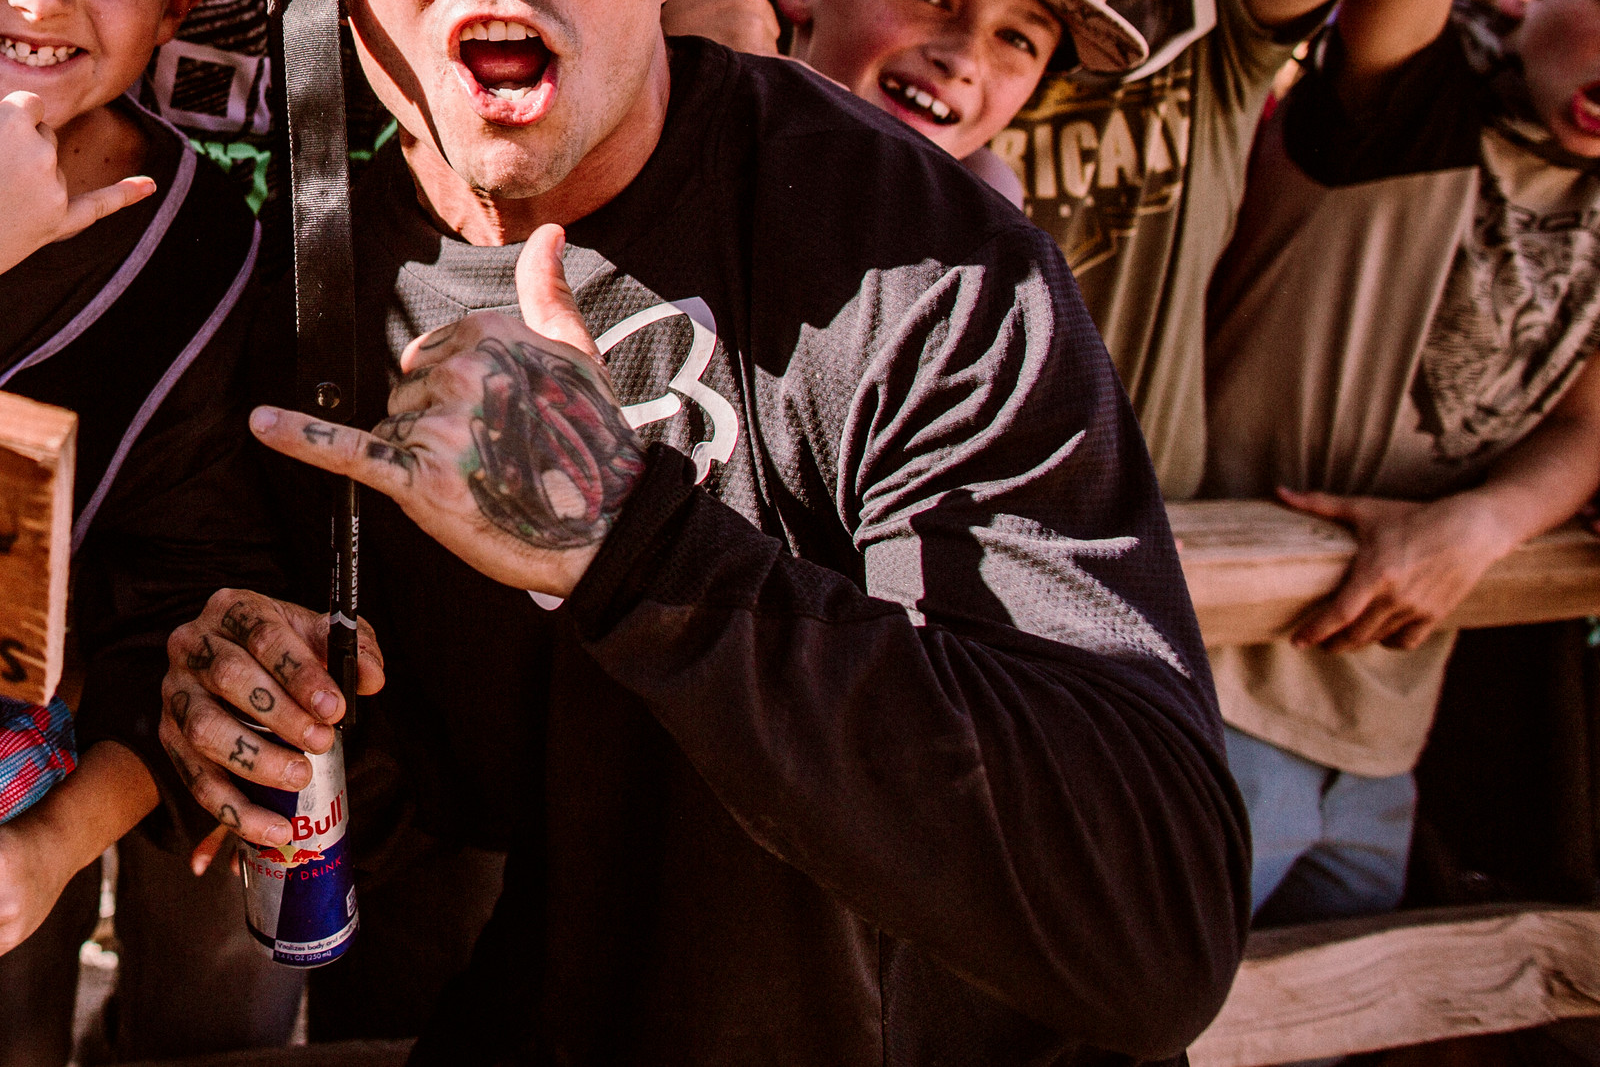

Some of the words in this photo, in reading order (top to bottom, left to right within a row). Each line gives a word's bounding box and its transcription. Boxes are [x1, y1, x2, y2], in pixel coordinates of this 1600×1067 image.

[291, 794, 343, 842] Bull
[247, 859, 294, 881] NERGY
[300, 855, 342, 881] DRINK
